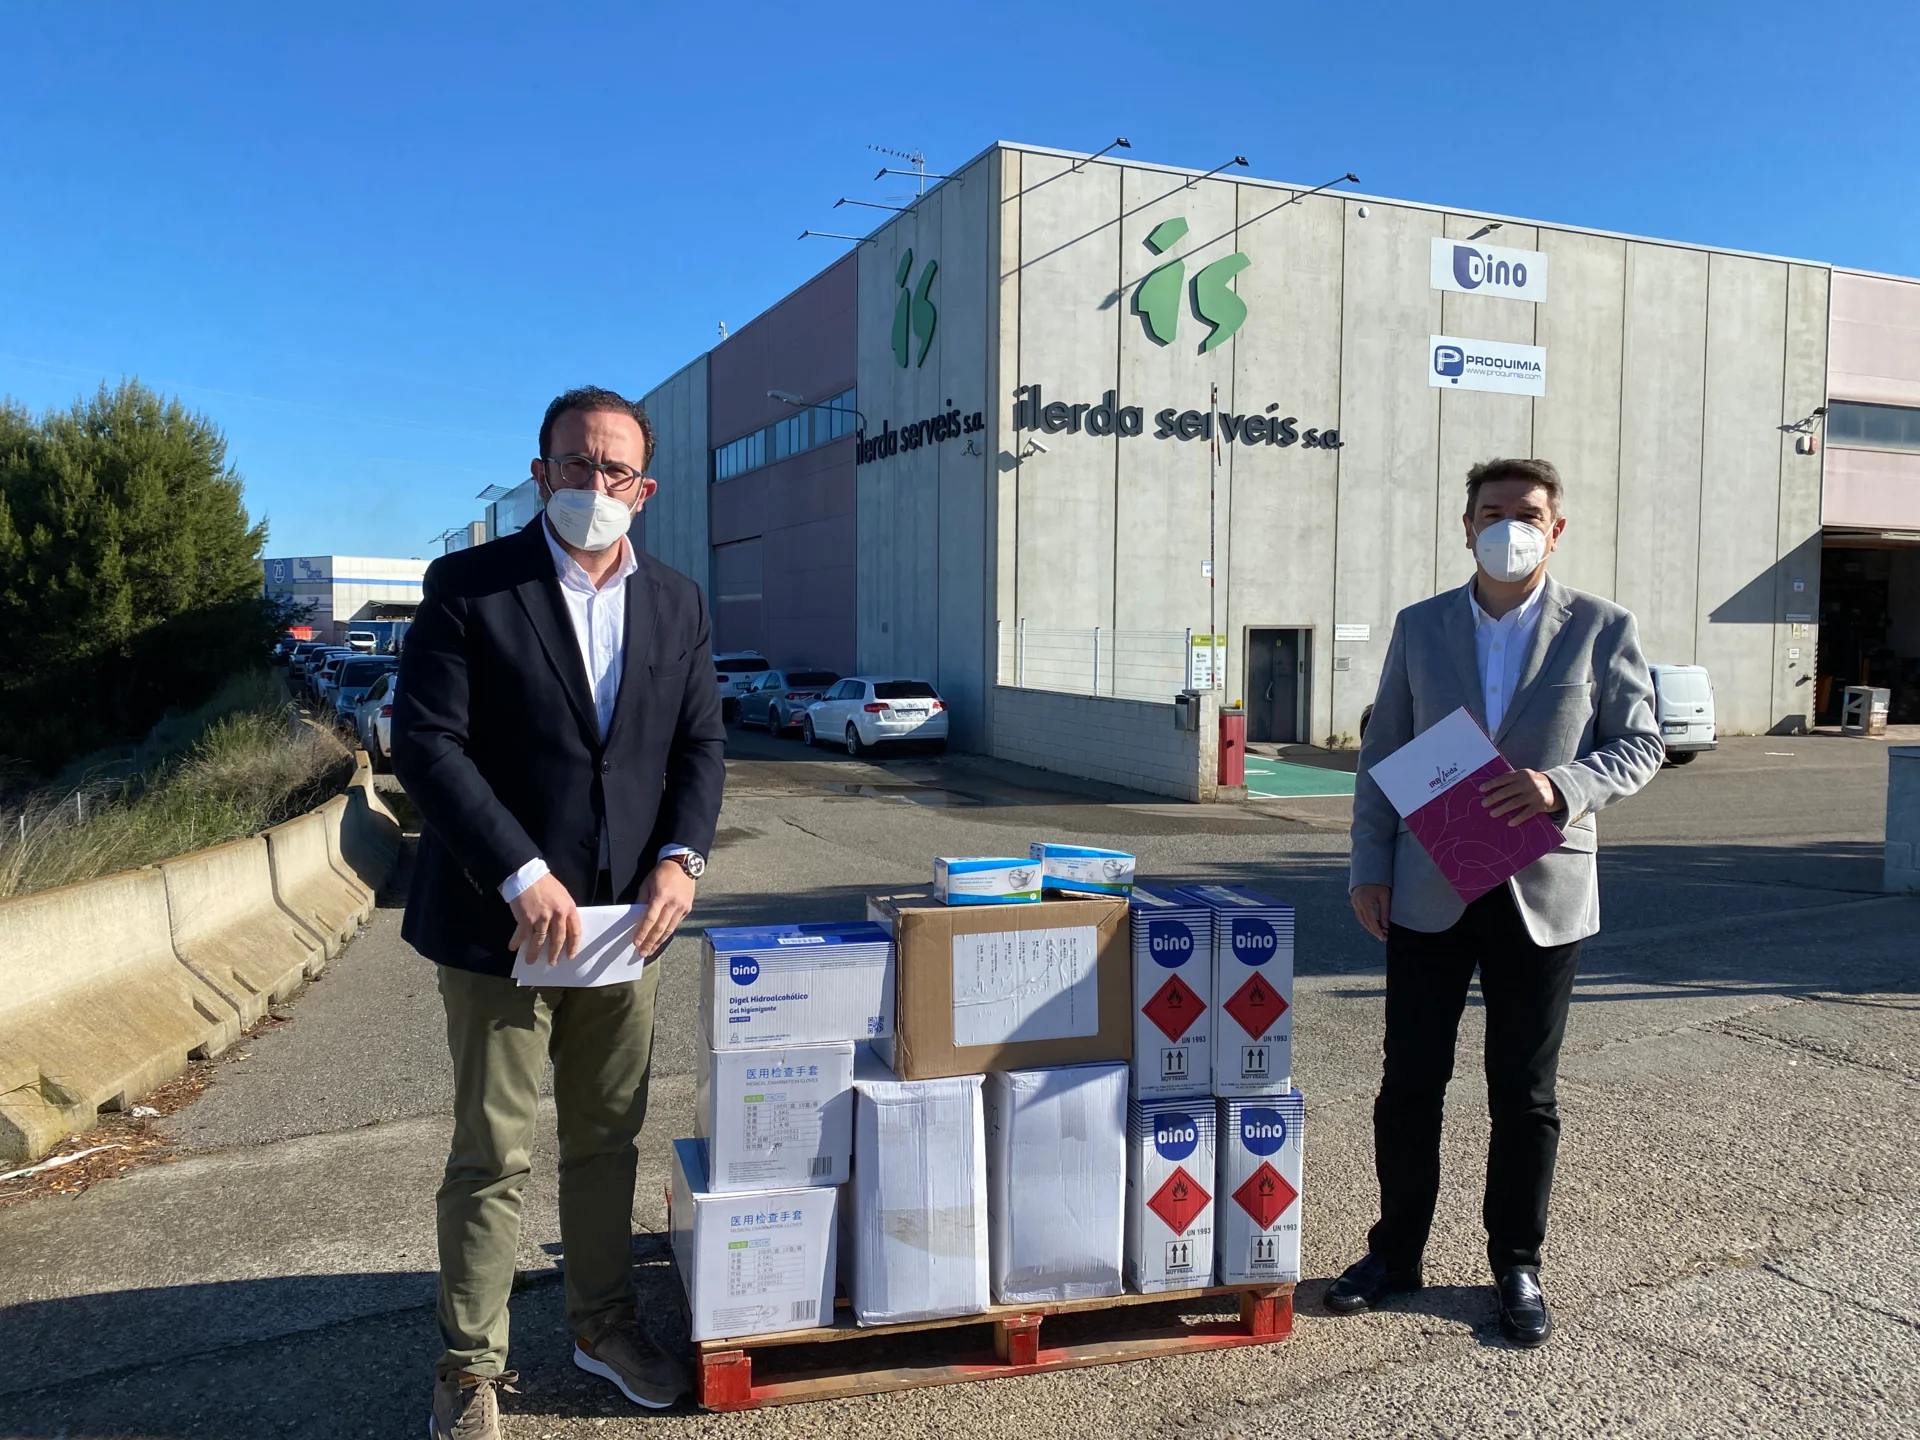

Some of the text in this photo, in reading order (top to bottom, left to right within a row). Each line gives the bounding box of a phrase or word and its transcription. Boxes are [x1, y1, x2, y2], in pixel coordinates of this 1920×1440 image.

[1467, 253, 1528, 288] Dino
[1466, 355, 1541, 372] PROQUIMIA
[1466, 367, 1541, 380] www.proquimia.com
[1012, 384, 1144, 438] ilerda
[857, 420, 898, 465] ilerda
[900, 399, 961, 452] serveis
[1153, 934, 1190, 951] Dino
[1236, 932, 1273, 949] Dino
[732, 964, 757, 976] Dino
[729, 993, 808, 1005] Digel Hidroalcohólico
[746, 1065, 818, 1080] 医用检查手套
[1157, 1127, 1195, 1144] Dino
[1245, 1122, 1283, 1139] Dino
[731, 1210, 802, 1227] 医用检查手套
[1197, 1227, 1211, 1235] 1993
